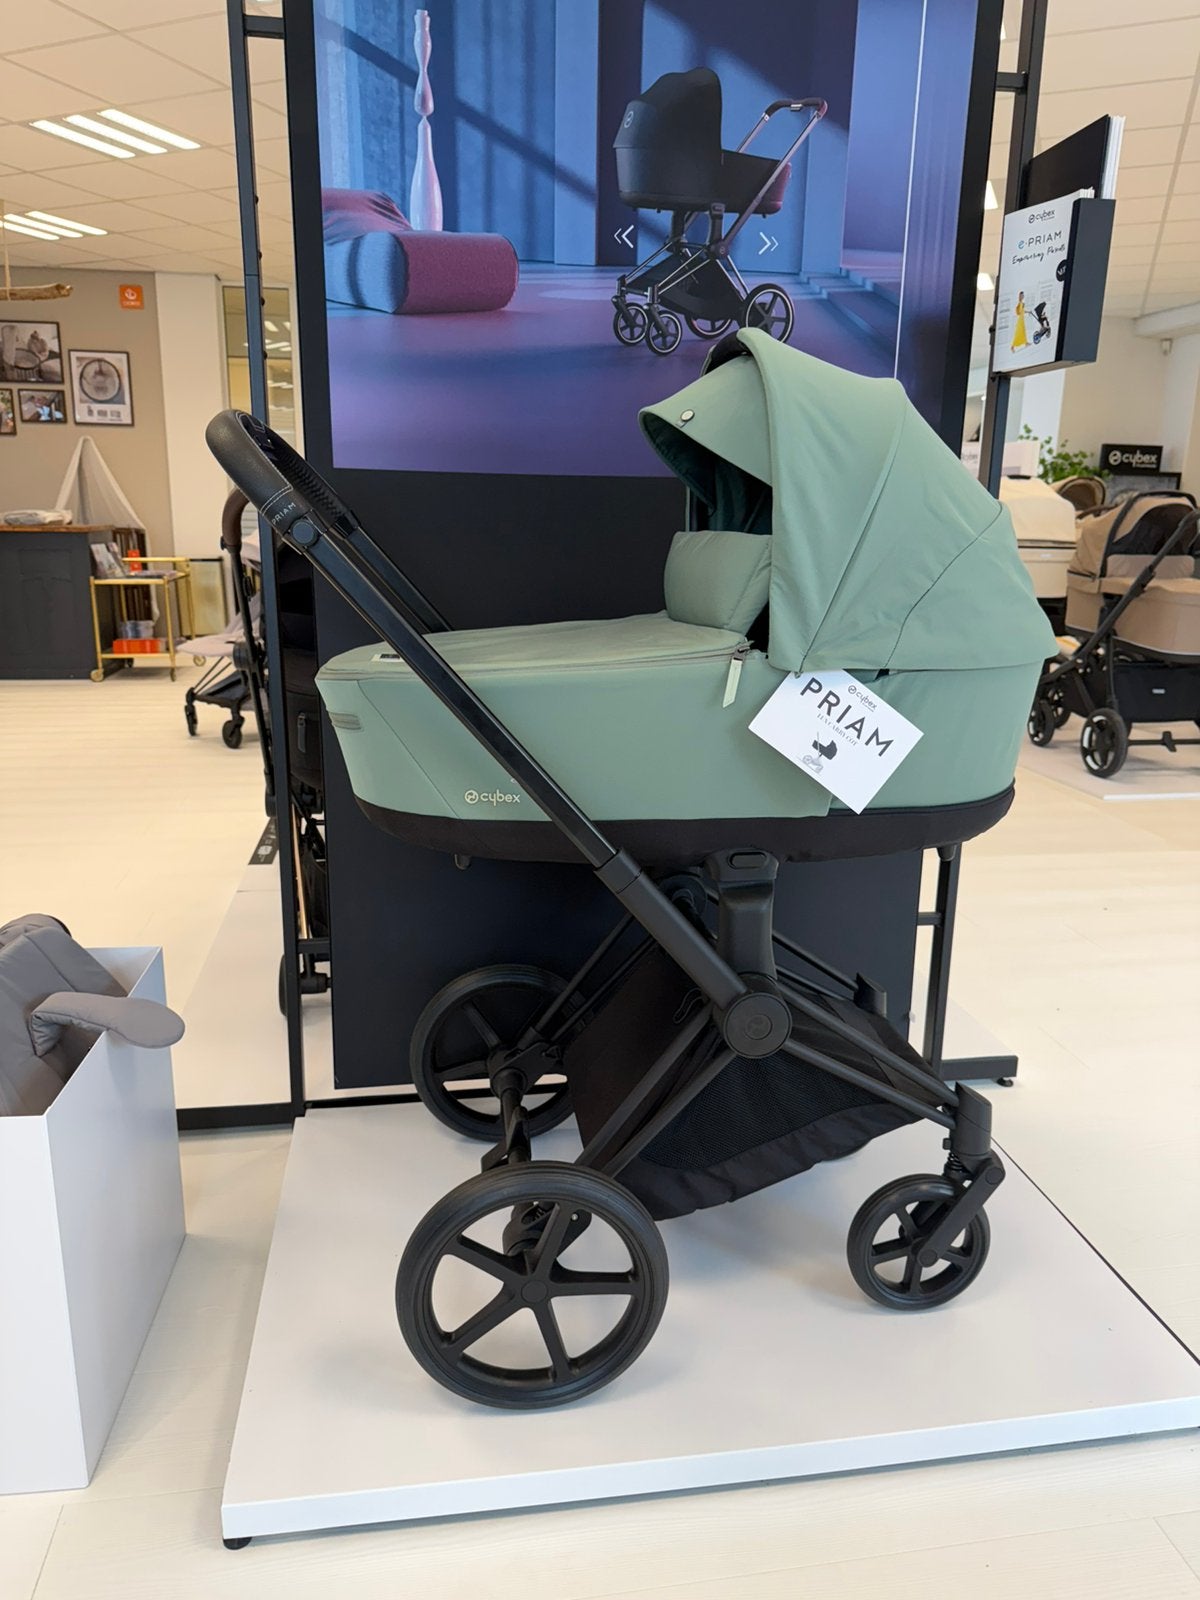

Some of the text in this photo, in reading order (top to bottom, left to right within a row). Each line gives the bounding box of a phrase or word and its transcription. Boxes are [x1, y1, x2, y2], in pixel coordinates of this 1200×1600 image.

[1036, 209, 1055, 221] cybex
[1122, 449, 1158, 468] cybex
[271, 502, 296, 525] PRIAM
[856, 691, 877, 710] cybex
[800, 677, 894, 757] PRIAM
[480, 788, 521, 807] cybex
